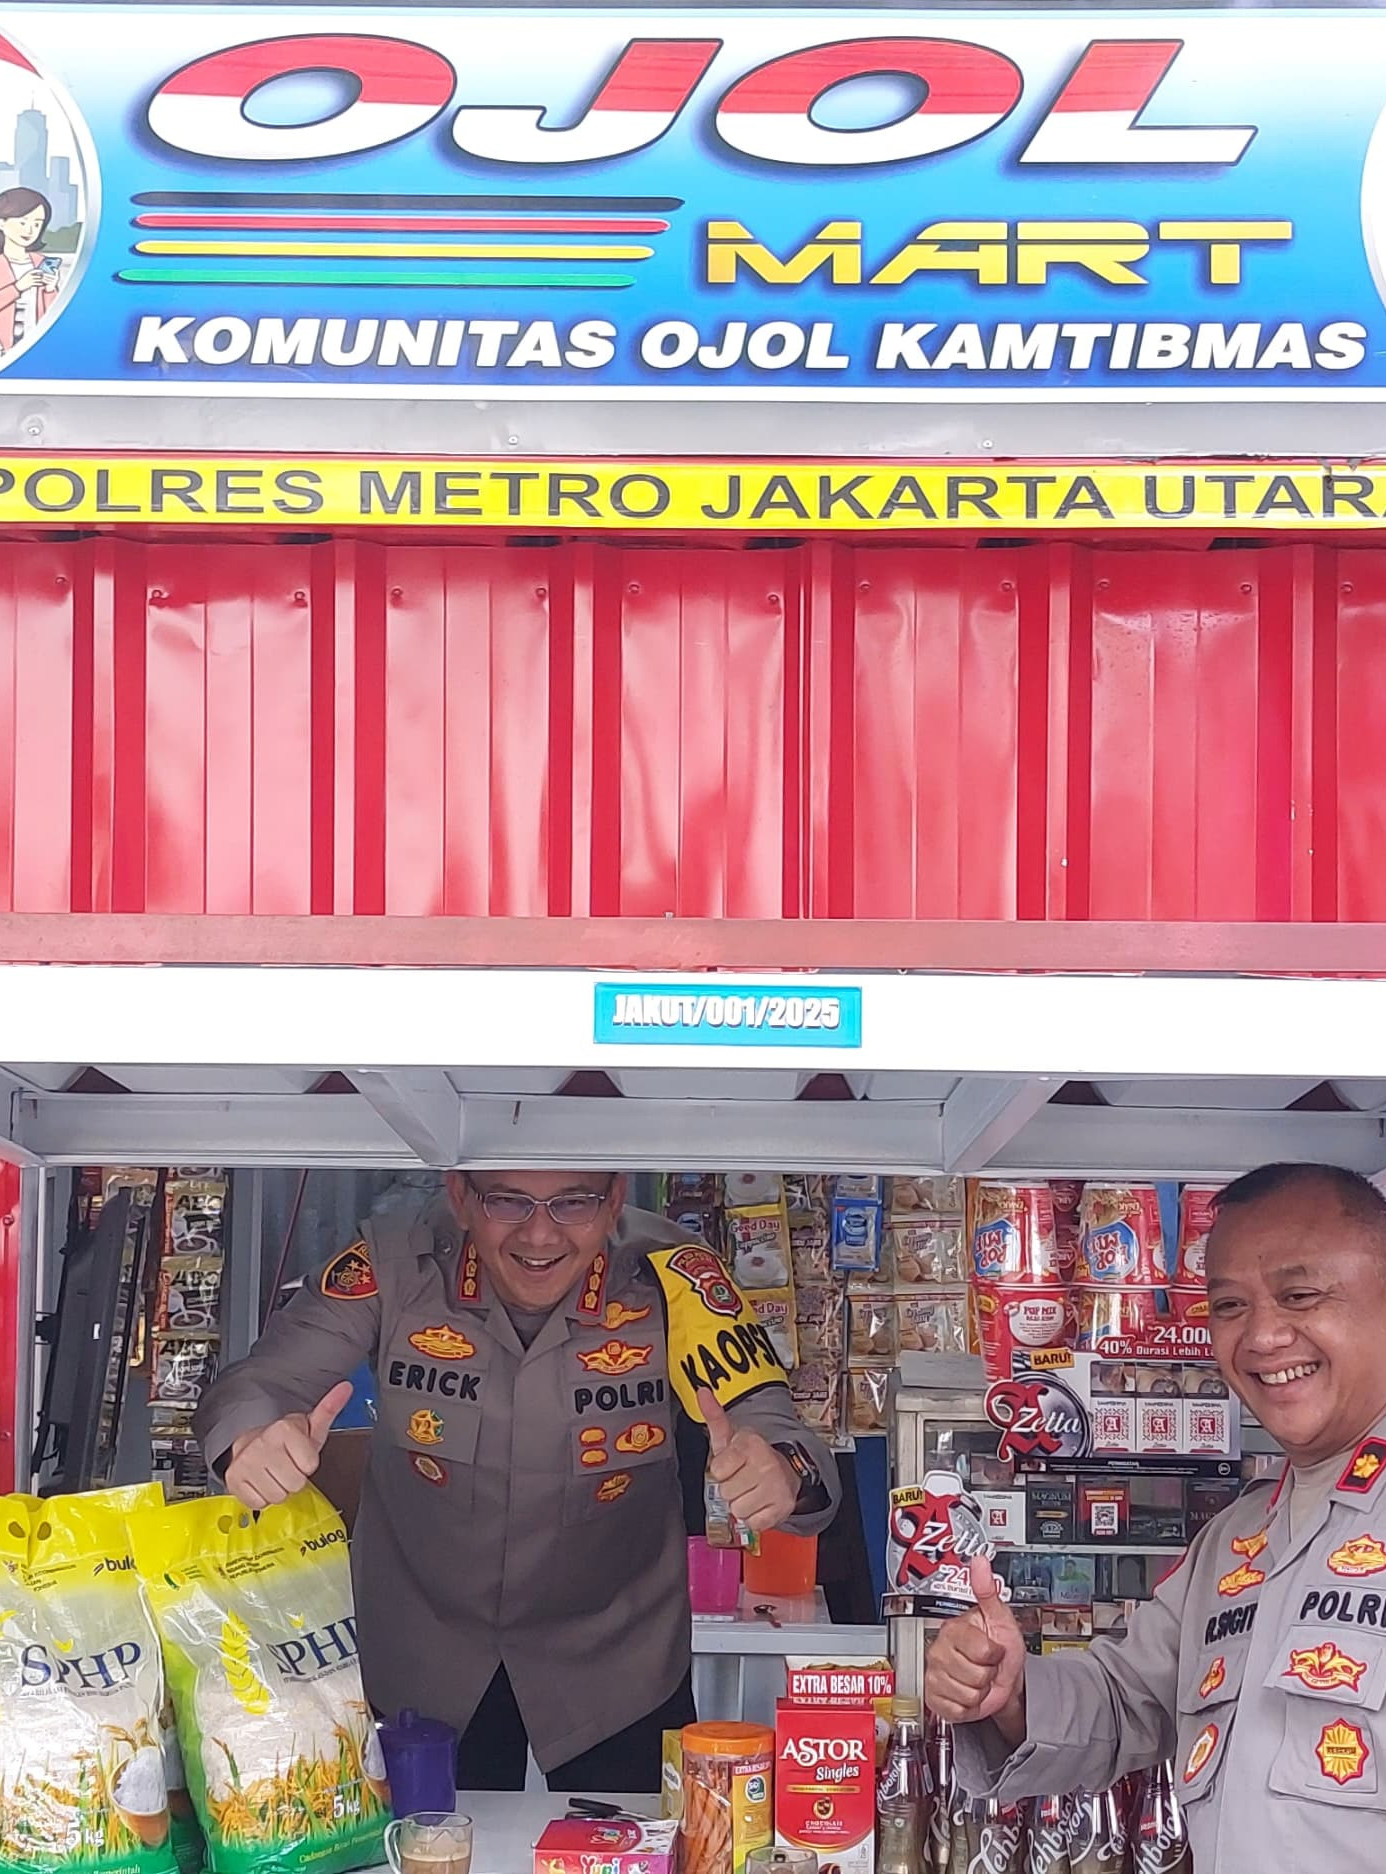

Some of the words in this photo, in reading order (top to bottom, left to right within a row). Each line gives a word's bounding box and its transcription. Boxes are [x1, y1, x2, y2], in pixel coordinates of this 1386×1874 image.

[148, 33, 1257, 166] OJOL
[707, 221, 1292, 284] MART
[132, 316, 616, 368] KOMUNITAS
[641, 321, 849, 369] OJOL
[875, 322, 1367, 370] KAMTIBMAS
[361, 471, 672, 518] METRO
[701, 475, 1117, 519] JAKARTA
[613, 994, 842, 1029] JAKUT/001/2025
[1034, 1351, 1072, 1366] BARU!
[1100, 1339, 1132, 1354] 40%
[1136, 1345, 1169, 1357] Durasi
[1173, 1345, 1201, 1357] Lebih
[388, 1360, 481, 1401] ERICK
[573, 1378, 664, 1415] POLRI
[1012, 1406, 1082, 1433] Zetta
[305, 1529, 346, 1552] bulog
[21, 1641, 141, 1689] SPHP
[792, 1675, 827, 1695] EXTRA
[830, 1675, 865, 1695] BESAR
[868, 1675, 892, 1695] 10%
[779, 1737, 868, 1767] ASTOR
[816, 1763, 860, 1784] Singles
[333, 1796, 345, 1818] 5
